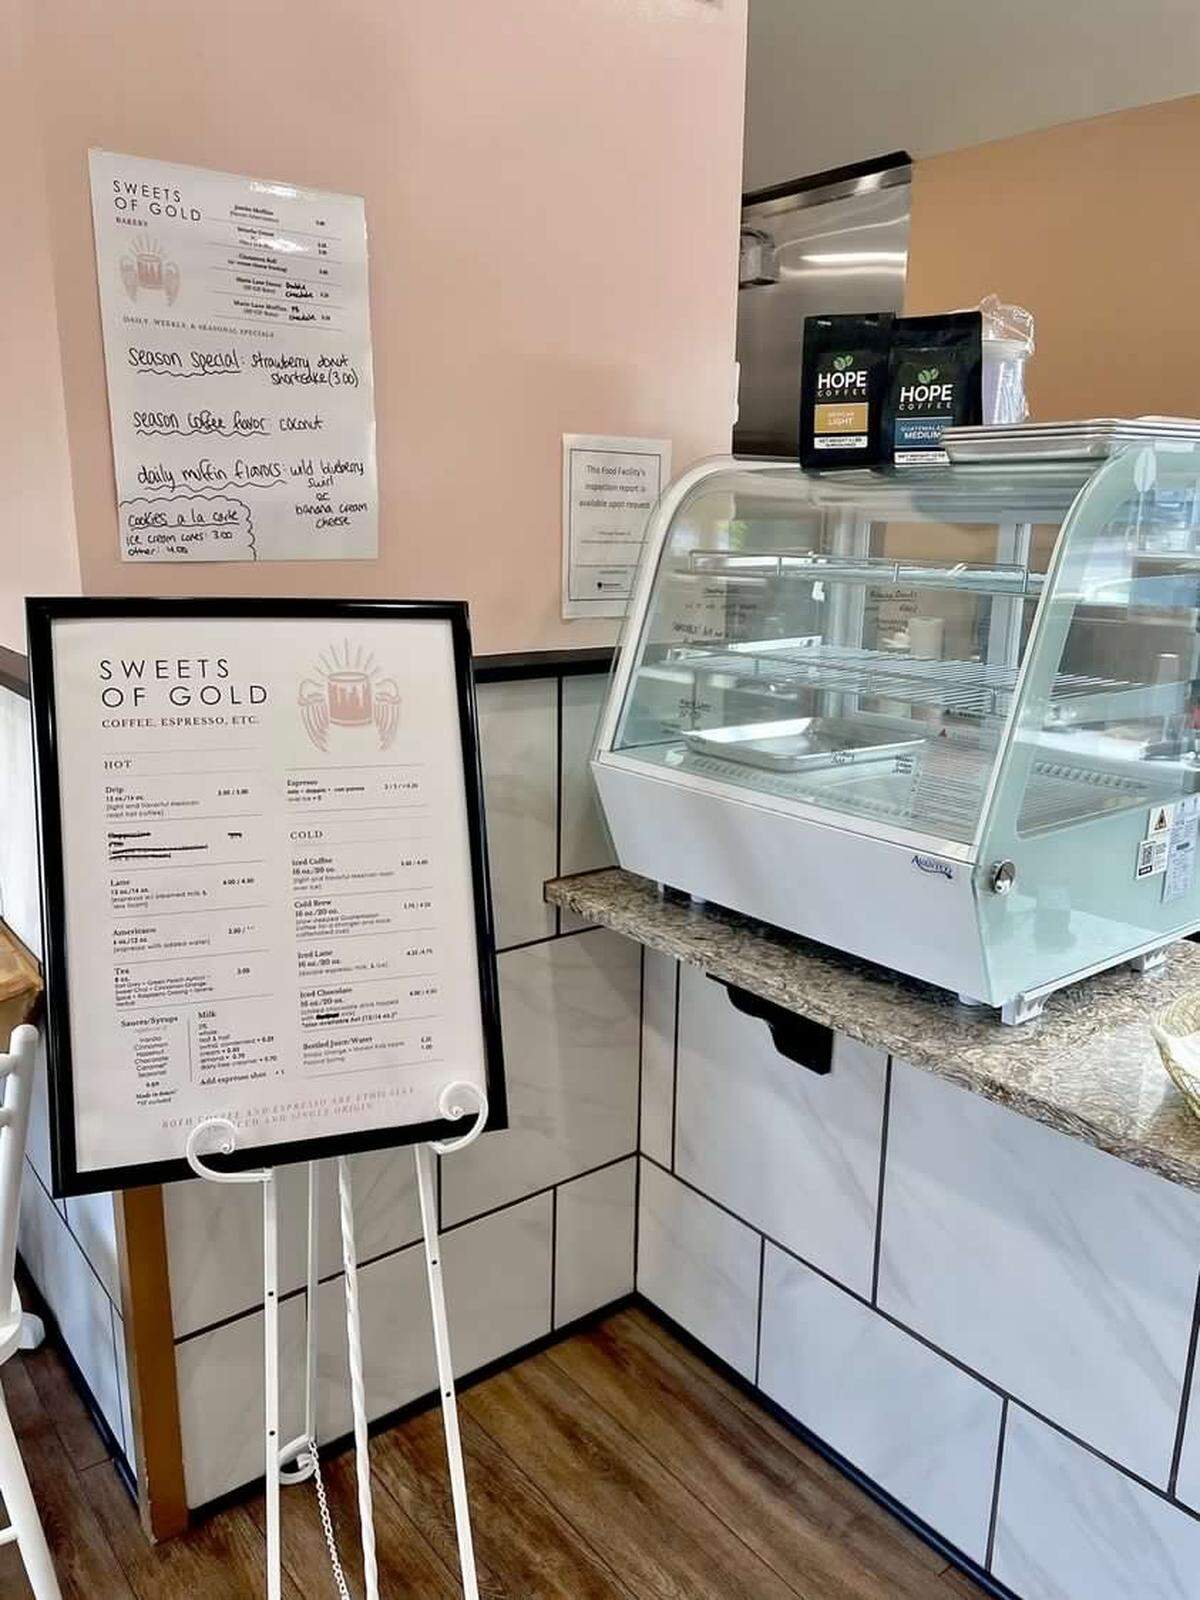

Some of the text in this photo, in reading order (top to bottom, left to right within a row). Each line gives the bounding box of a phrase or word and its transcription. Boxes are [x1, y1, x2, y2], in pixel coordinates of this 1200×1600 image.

[113, 180, 181, 203] SWEETS
[114, 196, 201, 222] OF GOLD
[115, 216, 148, 227] BAKERY
[251, 350, 312, 377] strawberry
[817, 371, 868, 390] HOPE
[817, 388, 867, 398] COFFEE
[899, 384, 954, 403] HOPE
[899, 401, 953, 411] COFFEE
[827, 416, 854, 427] LIGHT
[138, 464, 176, 493] daily
[182, 458, 228, 481] muffin
[295, 503, 334, 515] banana
[176, 514, 186, 526] a
[191, 507, 206, 523] la
[99, 658, 230, 681] SWEETS
[101, 684, 268, 708] OF GOLD
[101, 715, 260, 729] COFFEE, ESPRESSO, ETC.
[103, 758, 133, 771] HOT
[289, 830, 324, 841] COLD
[112, 926, 157, 937] Americano
[114, 967, 130, 976] Tea
[198, 1011, 217, 1020] Milk
